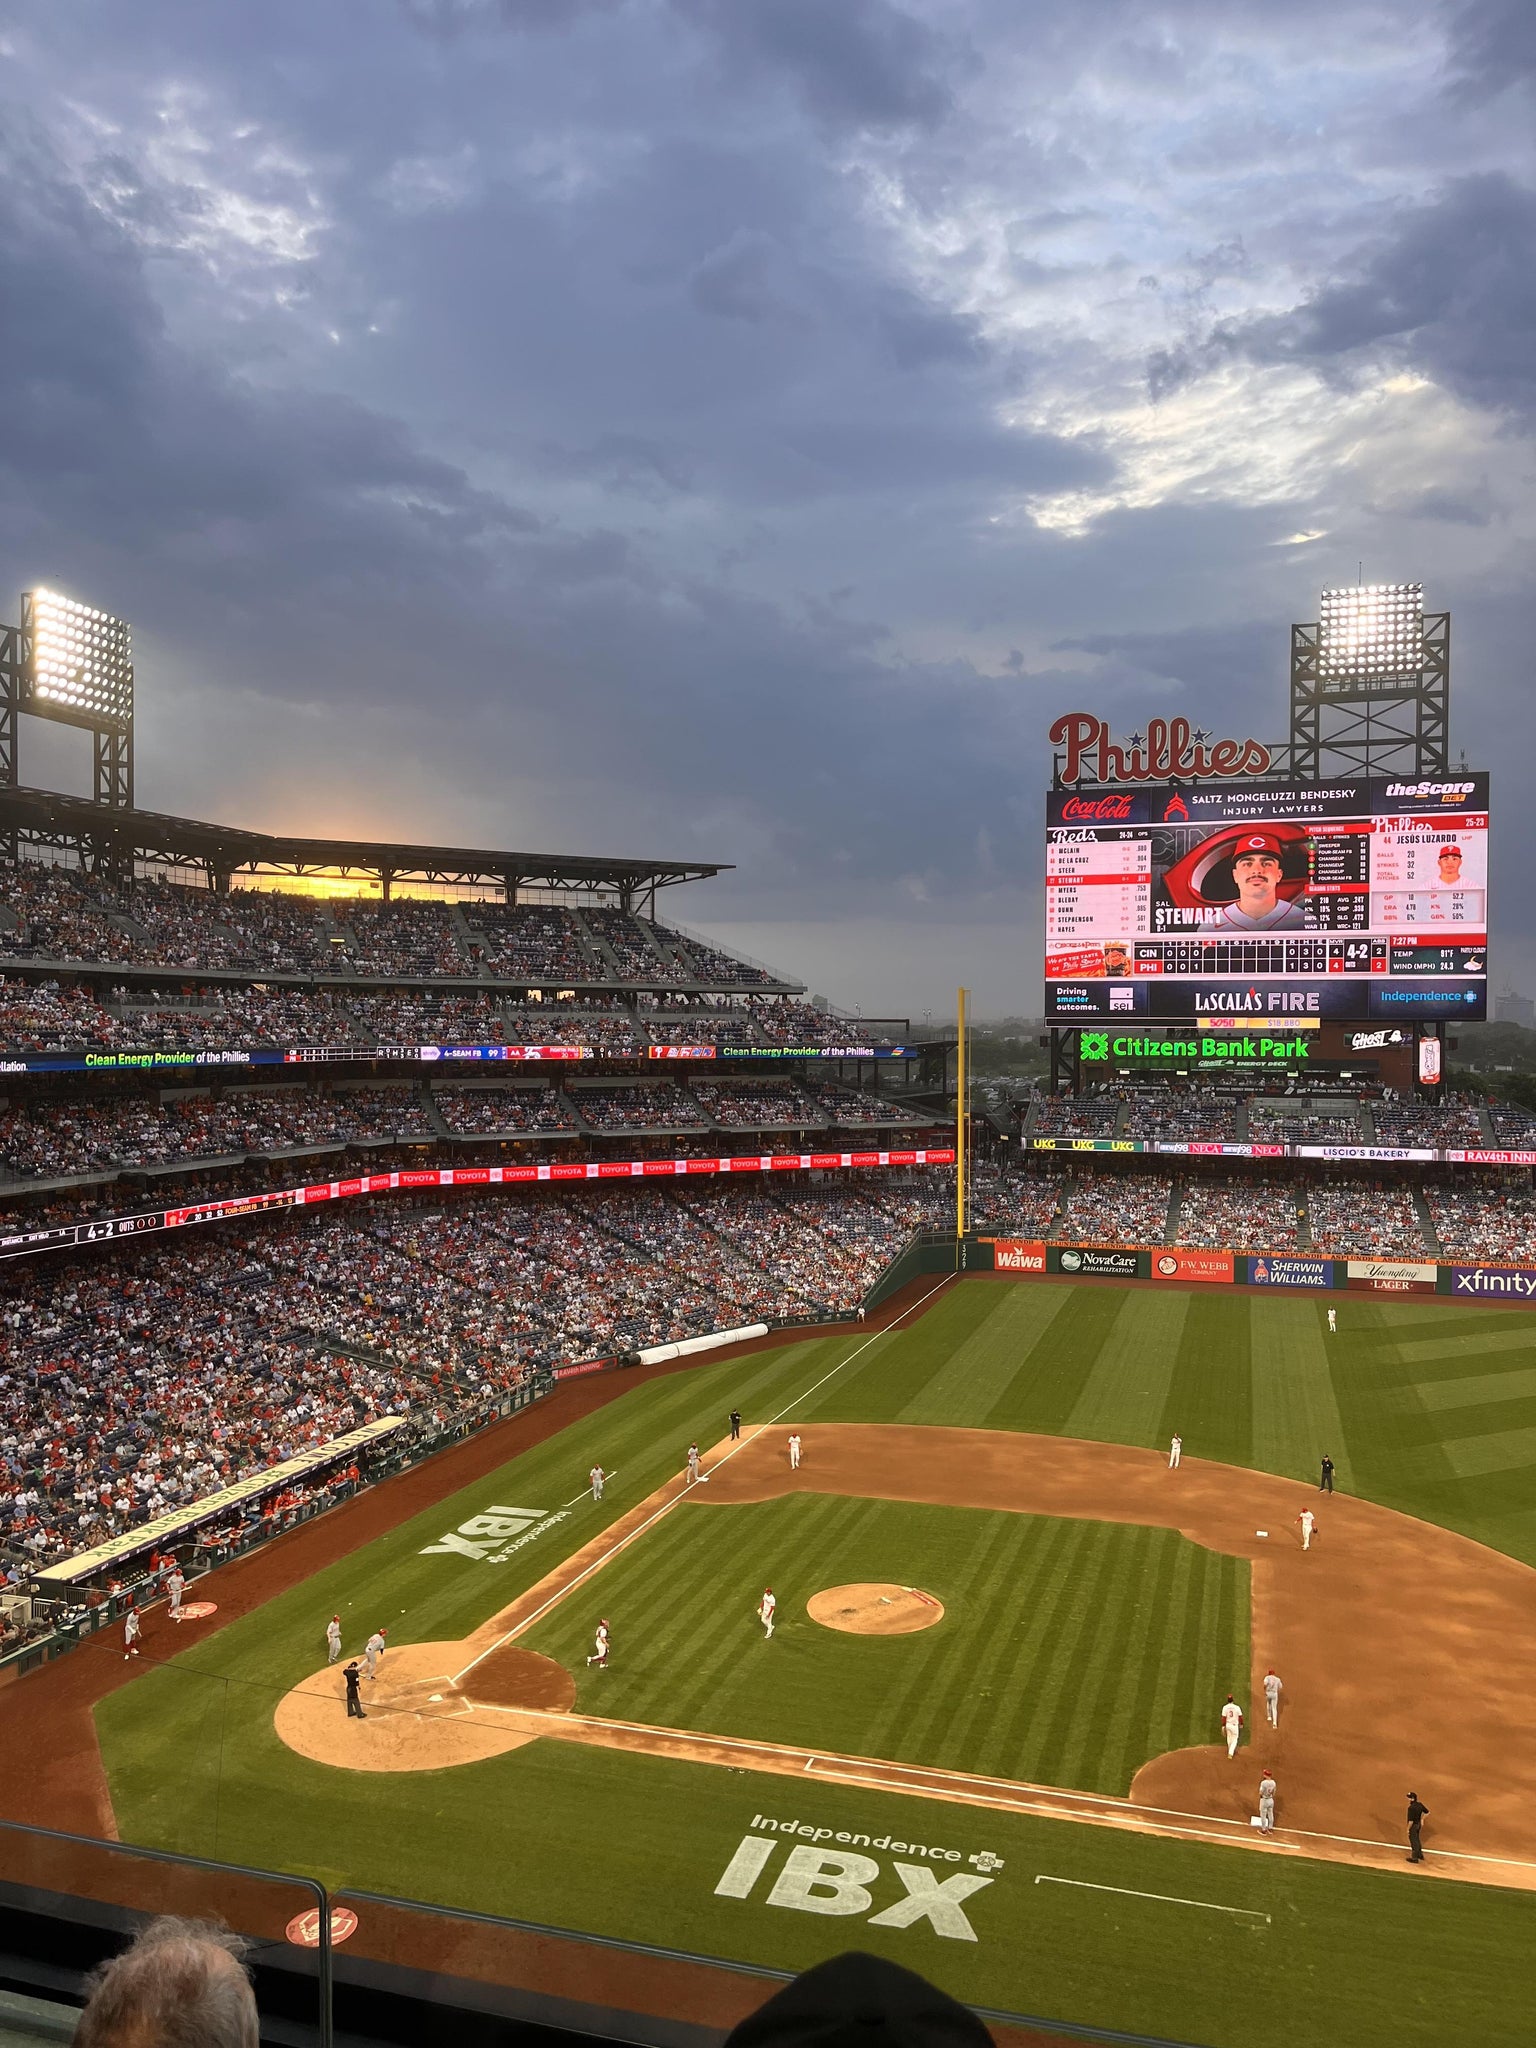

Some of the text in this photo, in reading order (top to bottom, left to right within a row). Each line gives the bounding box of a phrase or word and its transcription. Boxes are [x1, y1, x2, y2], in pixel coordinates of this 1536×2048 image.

[1048, 712, 1271, 784] Phillies
[1386, 782, 1475, 796] theScore
[1192, 789, 1356, 804] SALTZ MONGELUZZI BENDESKY
[1062, 795, 1135, 820] Coca-Cola
[1223, 804, 1324, 816] INJURY LAWYERS
[1371, 818, 1484, 832] Phillies 25-23
[1053, 829, 1098, 844] Reds
[1397, 834, 1419, 845] JESÚS
[1422, 834, 1456, 843] LUZARDO
[1156, 907, 1222, 924] STEWART
[1139, 950, 1157, 958] CIN
[1347, 944, 1368, 959] 4-2
[1140, 963, 1157, 971] PHI
[1056, 988, 1087, 996] Driving
[1381, 991, 1461, 1003] Independence
[1268, 992, 1320, 1011] FIRE
[1352, 1030, 1393, 1050] GHOST
[724, 1047, 874, 1058] Clean Energy Provider of the Phillies
[1113, 1037, 1309, 1057] Citizens Bank Park
[444, 1049, 472, 1057] 4-SEAM
[473, 1049, 482, 1057] FB
[488, 1049, 499, 1057] 99
[86, 1051, 250, 1068] Clean Energy Provider of the Phillies
[1034, 1139, 1056, 1149] UKG
[1072, 1140, 1094, 1151] UKG
[1111, 1142, 1134, 1151] UKG
[1192, 1144, 1220, 1154] NECA
[1255, 1145, 1282, 1156] NECA
[1323, 1148, 1411, 1159] LISCIO'S BAKERY
[853, 1156, 877, 1164] TOYOTA
[891, 1154, 914, 1162] TOYOTA
[927, 1153, 951, 1161] TOYOTA
[1468, 1151, 1508, 1162] RAV4th
[645, 1164, 674, 1172] TOYOTA
[689, 1162, 716, 1170] TOYOTA
[733, 1160, 759, 1168] TOYOTA
[773, 1159, 799, 1167] TOYOTA
[505, 1170, 536, 1178] TOYOTA
[553, 1168, 582, 1176] TOYOTA
[601, 1166, 629, 1174] TOYOTA
[403, 1174, 435, 1183] TOYOTA
[456, 1172, 487, 1181] TOYOTA
[307, 1189, 328, 1199] TOYOTA
[340, 1184, 360, 1194] TOYOTA
[119, 1220, 134, 1233] OUTS
[997, 1253, 1043, 1268] Wawa
[1082, 1252, 1136, 1267] NovaCare
[1331, 1254, 1374, 1262] ASPLUNDH
[1435, 1259, 1480, 1267] ASPLUNDH
[1083, 1266, 1134, 1274] REHABILITATION
[1199, 1262, 1229, 1271] WEBB
[1271, 1260, 1324, 1273] SHERWIN
[1364, 1263, 1418, 1280] Yuengling
[1489, 1262, 1535, 1270] ASPLUNDH
[1373, 1280, 1410, 1290] LAGER
[1457, 1269, 1536, 1297] xfinity
[294, 1427, 383, 1464] WELCOME
[87, 1476, 269, 1558] Citizens Bank Park
[418, 1505, 549, 1560] IBX
[501, 1510, 572, 1555] Independence
[750, 1814, 962, 1862] Independence
[714, 1836, 995, 1942] IBX
